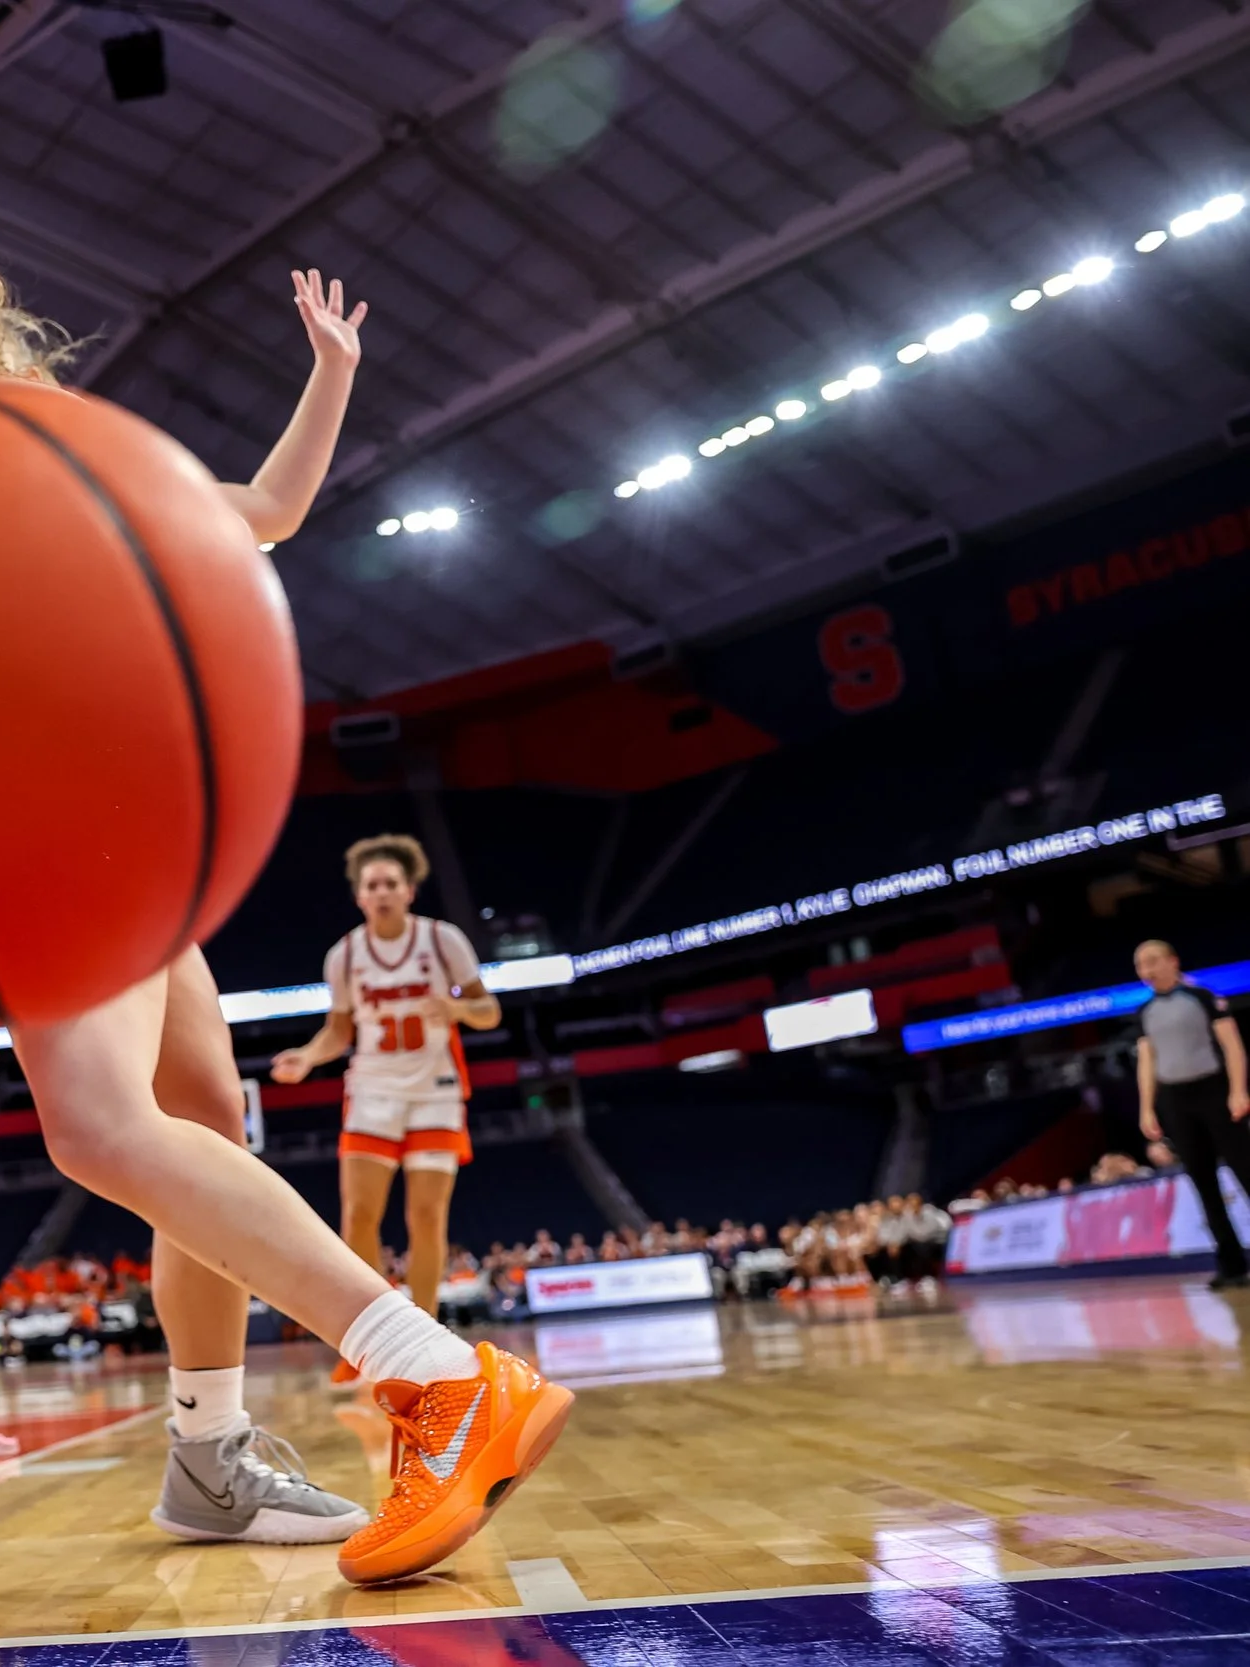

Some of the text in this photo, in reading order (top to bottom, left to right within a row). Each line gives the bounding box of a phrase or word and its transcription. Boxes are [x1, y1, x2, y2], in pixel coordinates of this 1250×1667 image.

[1007, 506, 1250, 628] SYRACUS
[818, 604, 906, 715] S
[953, 848, 1009, 882] FOUL
[1006, 826, 1099, 868] NUMBER
[1097, 813, 1149, 846] ONE
[1146, 806, 1177, 834] IN
[1173, 793, 1226, 826] THE
